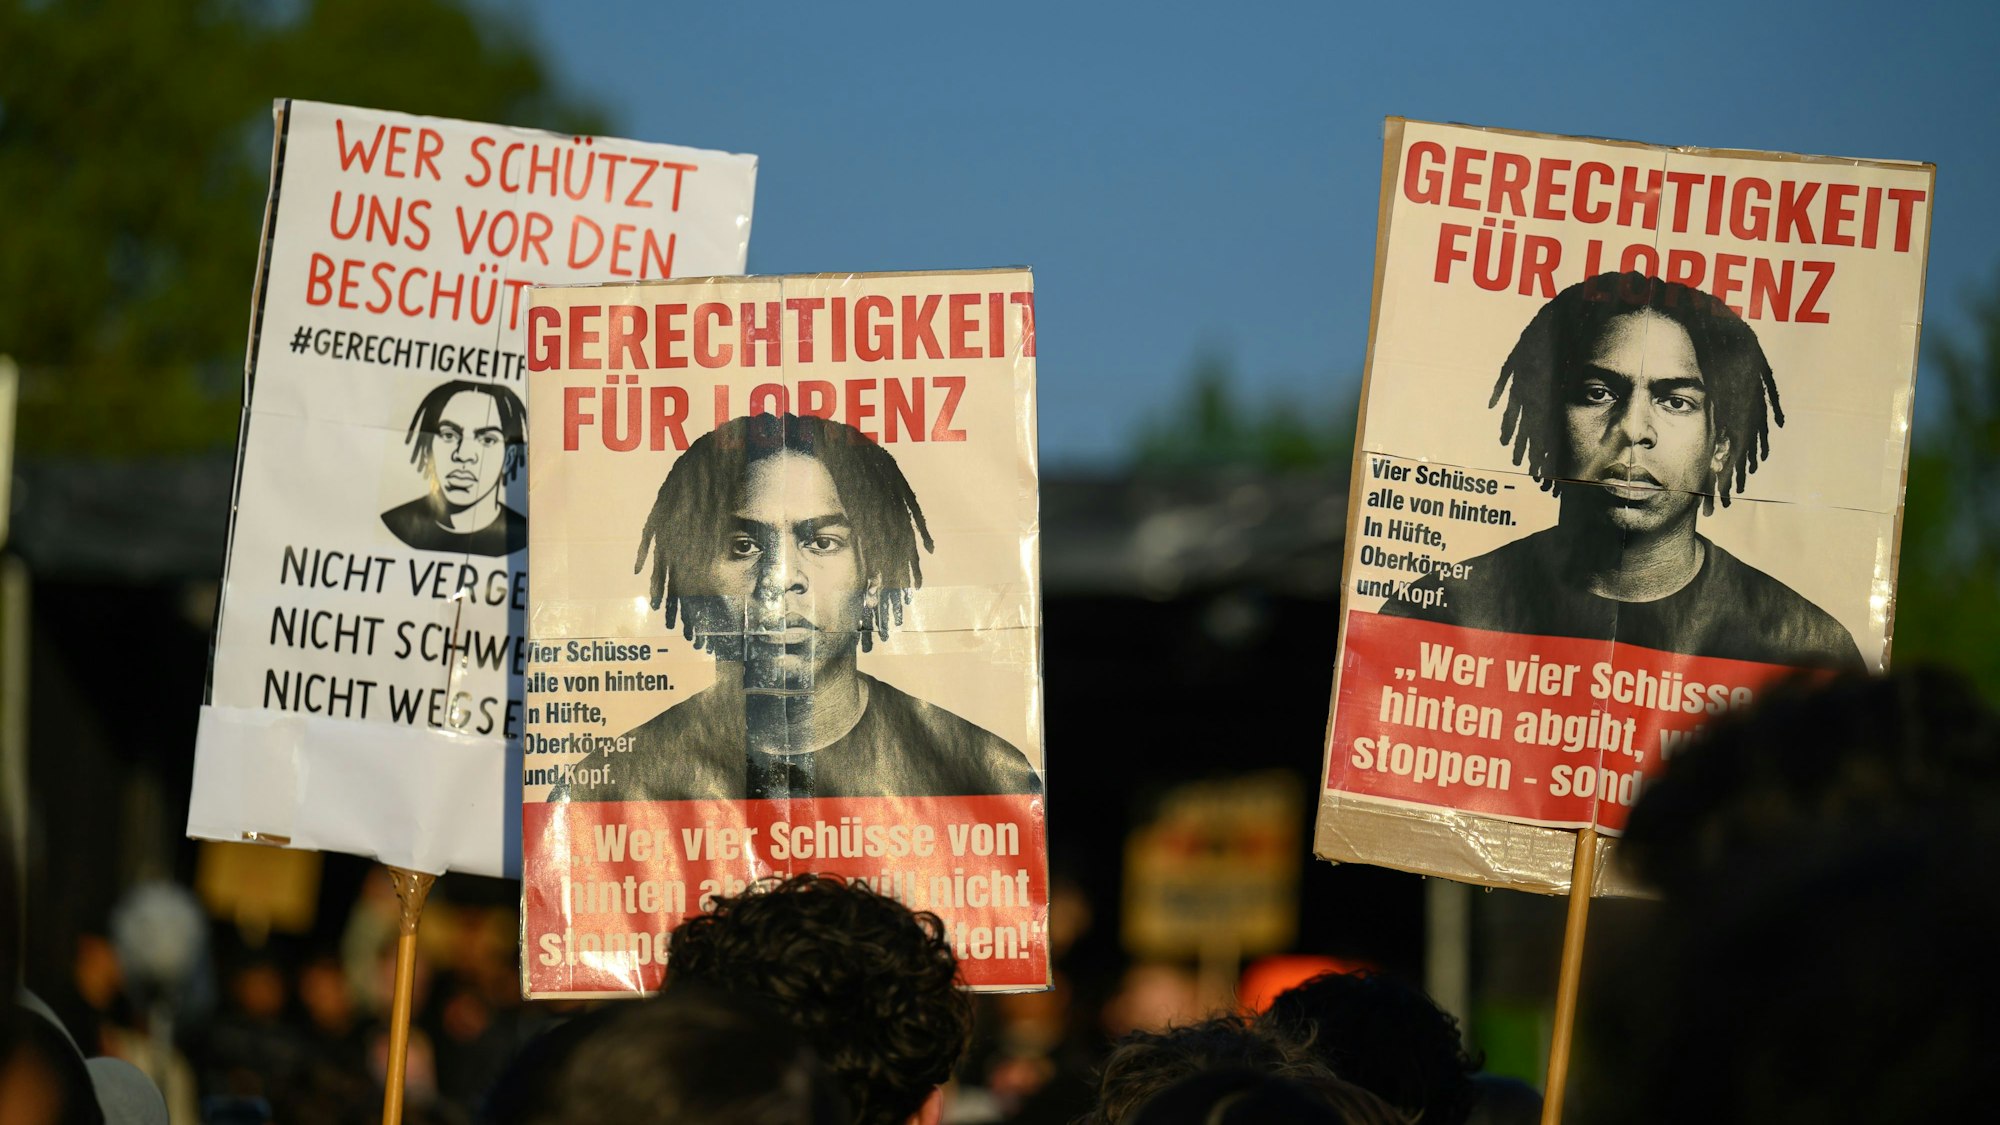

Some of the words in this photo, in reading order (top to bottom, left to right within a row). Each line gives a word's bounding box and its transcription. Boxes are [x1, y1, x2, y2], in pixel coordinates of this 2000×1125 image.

[336, 119, 444, 181] WER
[465, 136, 698, 212] SCHÜTZT
[1403, 140, 1925, 253] GERECHTIGKEIT
[330, 191, 432, 251] UNS
[456, 205, 554, 265] VOR
[567, 215, 676, 279] DEN
[306, 253, 535, 331] BESCHÜT
[1433, 217, 1562, 300] FÜR
[1584, 239, 1836, 324] LORENZ
[528, 292, 1037, 371] GERECHTIGKEIT
[563, 374, 689, 451] FÜR
[714, 376, 967, 447] LORENZ
[1372, 458, 1411, 481] Vier
[1415, 465, 1498, 495] Schüsse
[1364, 516, 1382, 537] In
[1387, 519, 1447, 551] Hüfte,
[1367, 488, 1404, 510] alle
[1410, 496, 1444, 517] von
[1449, 499, 1516, 526] hinten.
[281, 545, 395, 593] NICHT
[409, 559, 526, 610] VERGE
[1360, 545, 1473, 581] Oberkörper
[1356, 579, 1394, 598] und
[1398, 581, 1448, 609] Kopf.
[270, 606, 384, 655] NICHT
[566, 641, 651, 662] Schüsse
[263, 668, 377, 719] NICHT
[389, 685, 522, 739] WEGSE
[564, 676, 599, 692] von
[605, 671, 674, 692] hinten.
[1394, 641, 1494, 688] „Wer
[1506, 655, 1581, 696] vier
[1590, 661, 1754, 717] Schüsse
[546, 702, 607, 726] Hüfte,
[1379, 685, 1503, 740] hinten
[1514, 708, 1644, 763] abgibt,
[564, 764, 615, 789] Kopf.
[1351, 735, 1512, 790] stoppen
[571, 824, 669, 867] „Wer
[681, 820, 758, 861] vier
[770, 816, 936, 861] Schüsse
[948, 821, 1019, 857] von
[560, 874, 686, 914] hinten
[930, 868, 1031, 909] nicht
